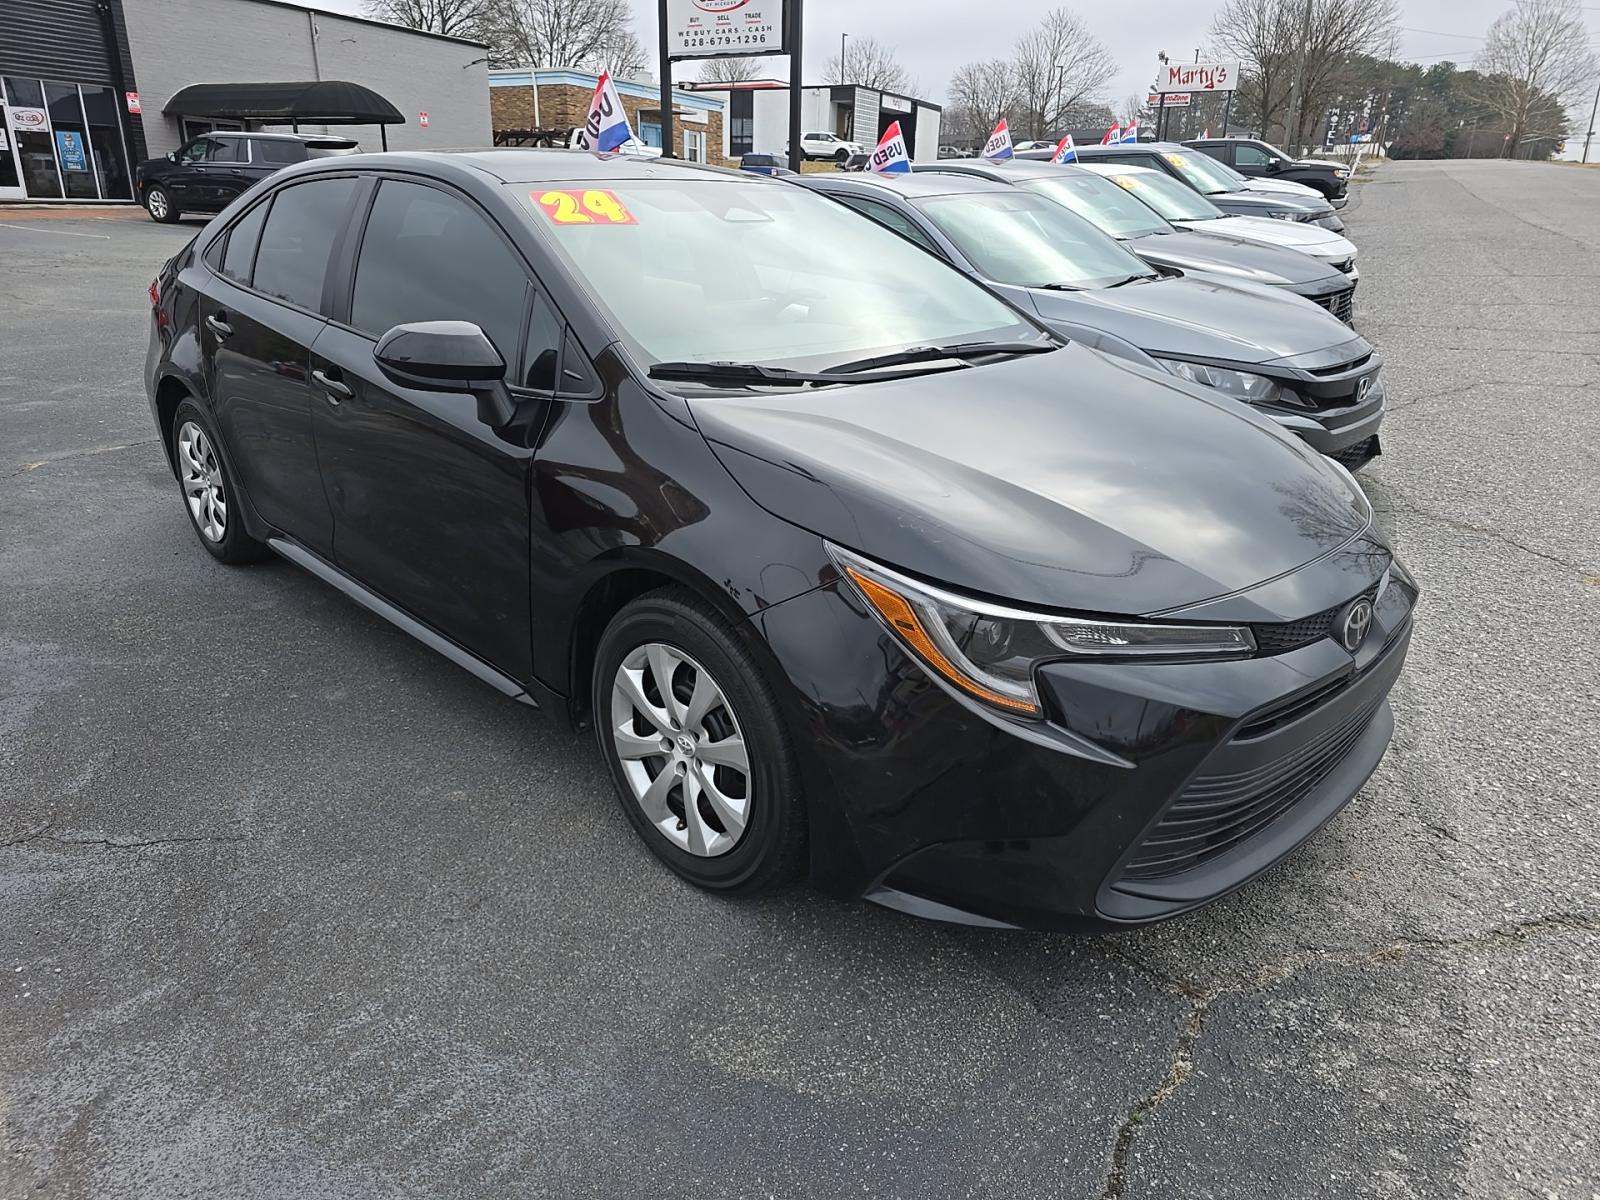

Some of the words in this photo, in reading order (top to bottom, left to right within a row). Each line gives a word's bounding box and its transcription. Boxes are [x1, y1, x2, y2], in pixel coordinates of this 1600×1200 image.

[716, 27, 739, 35] CARS
[684, 34, 766, 47] 828-679-1296
[1169, 65, 1226, 89] Marty's
[540, 190, 627, 223] 24
